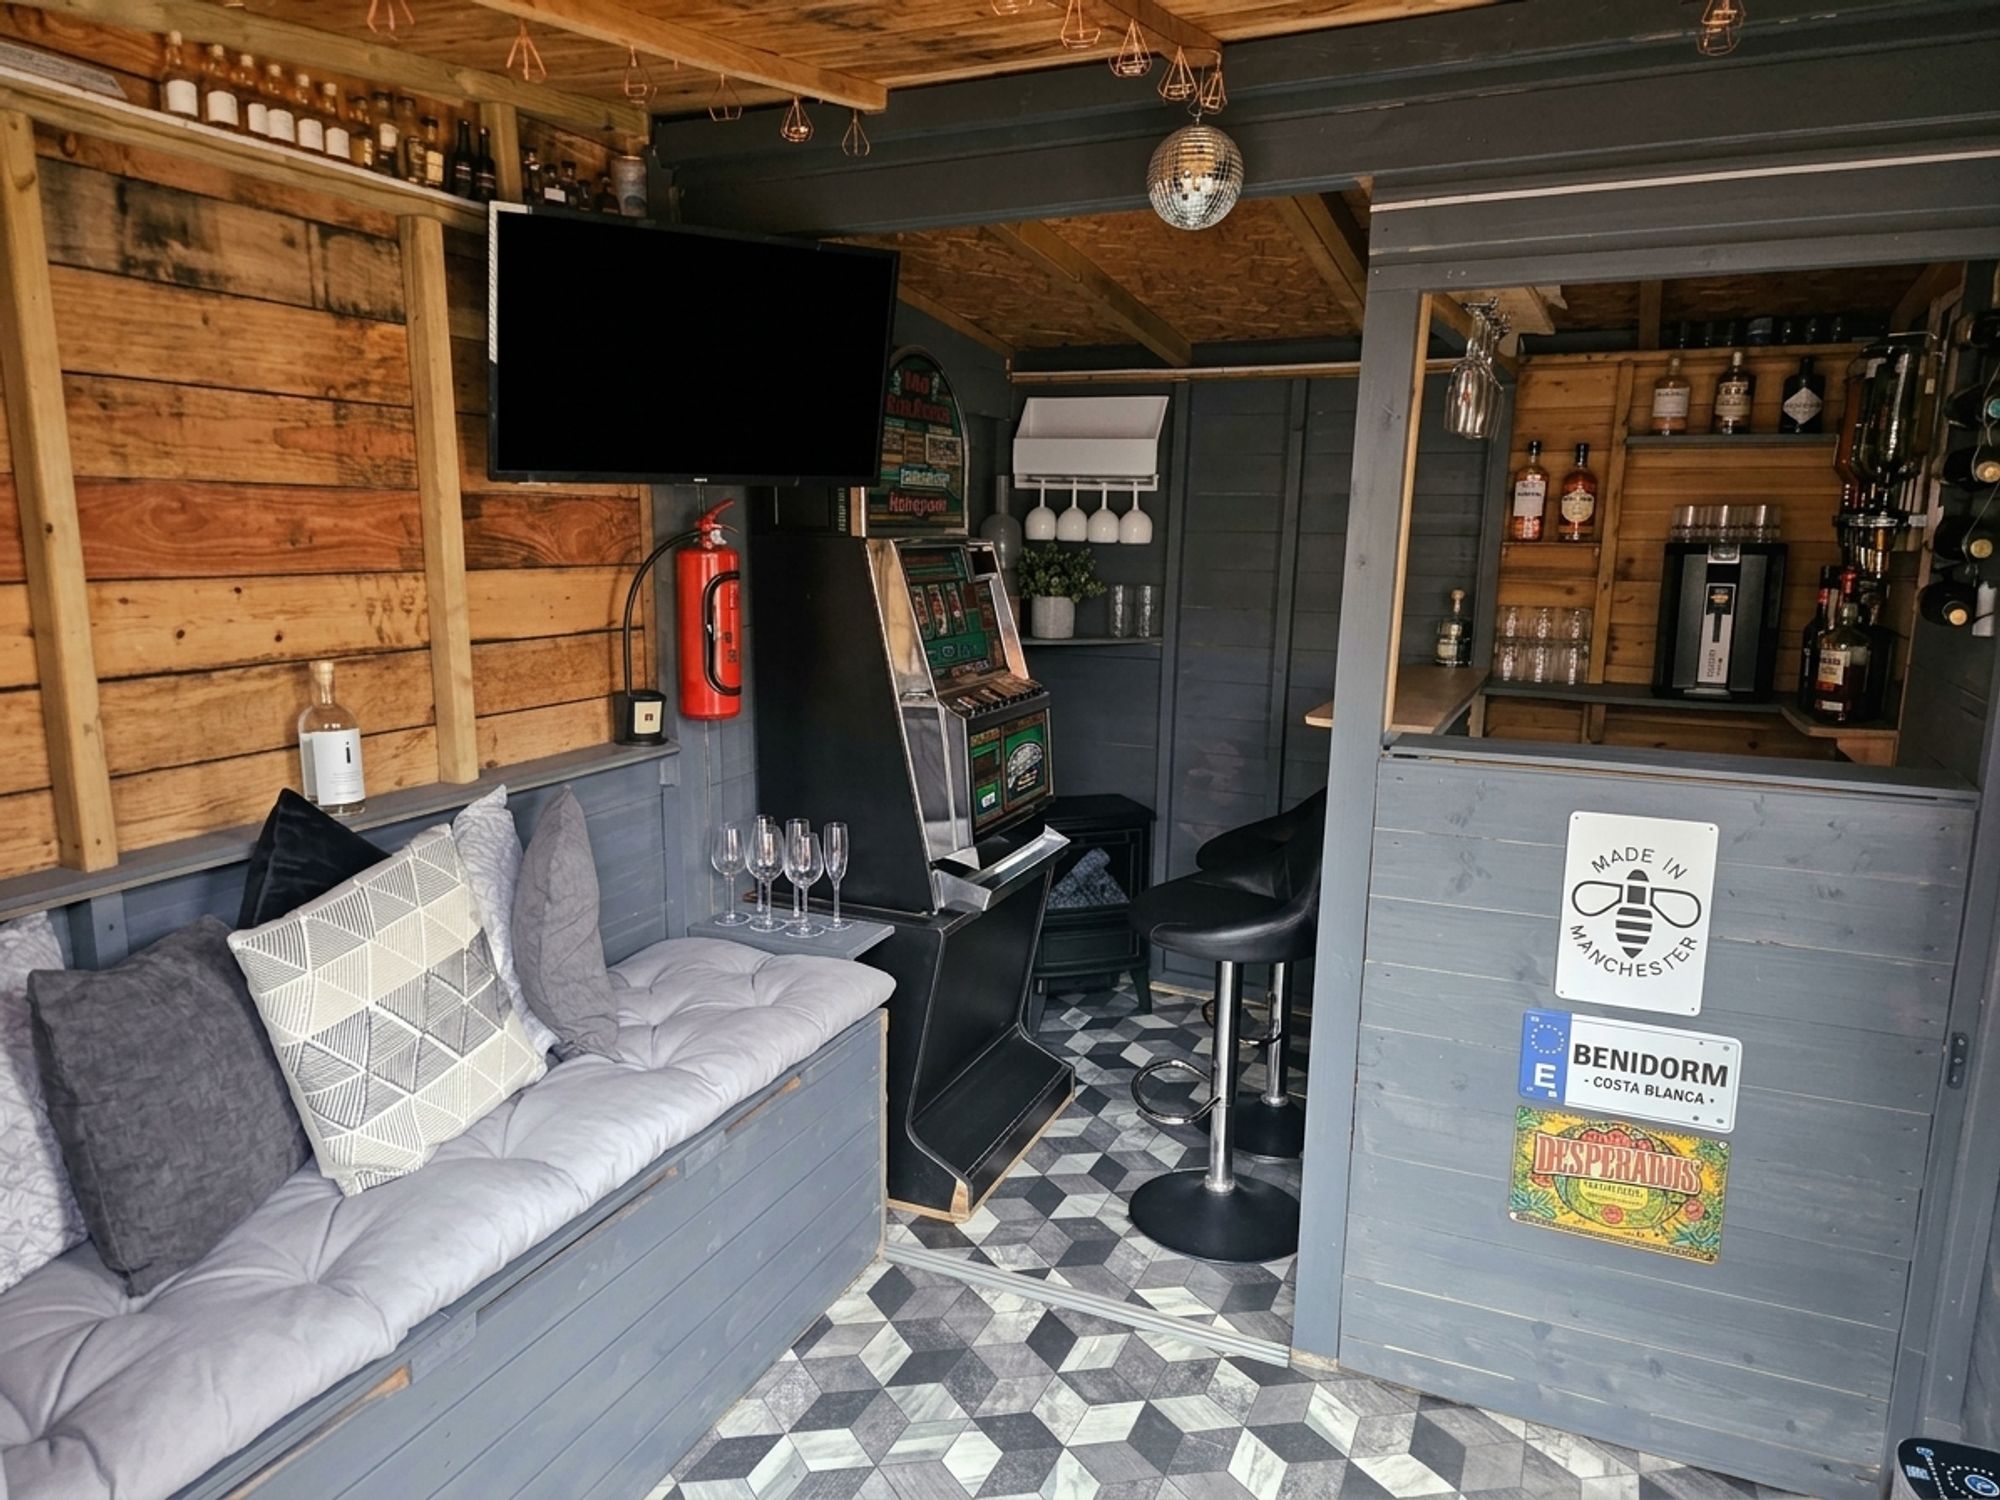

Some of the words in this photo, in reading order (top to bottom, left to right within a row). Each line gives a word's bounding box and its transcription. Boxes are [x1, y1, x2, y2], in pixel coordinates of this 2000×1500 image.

[1591, 846, 1656, 874] MADE
[1662, 857, 1689, 880] IN
[1570, 924, 1698, 977] MANCHESTER
[1533, 1062, 1557, 1090] E
[1573, 1043, 1729, 1088] BENIDORM
[1593, 1076, 1640, 1096] COSTA
[1645, 1083, 1705, 1105] BLANCA
